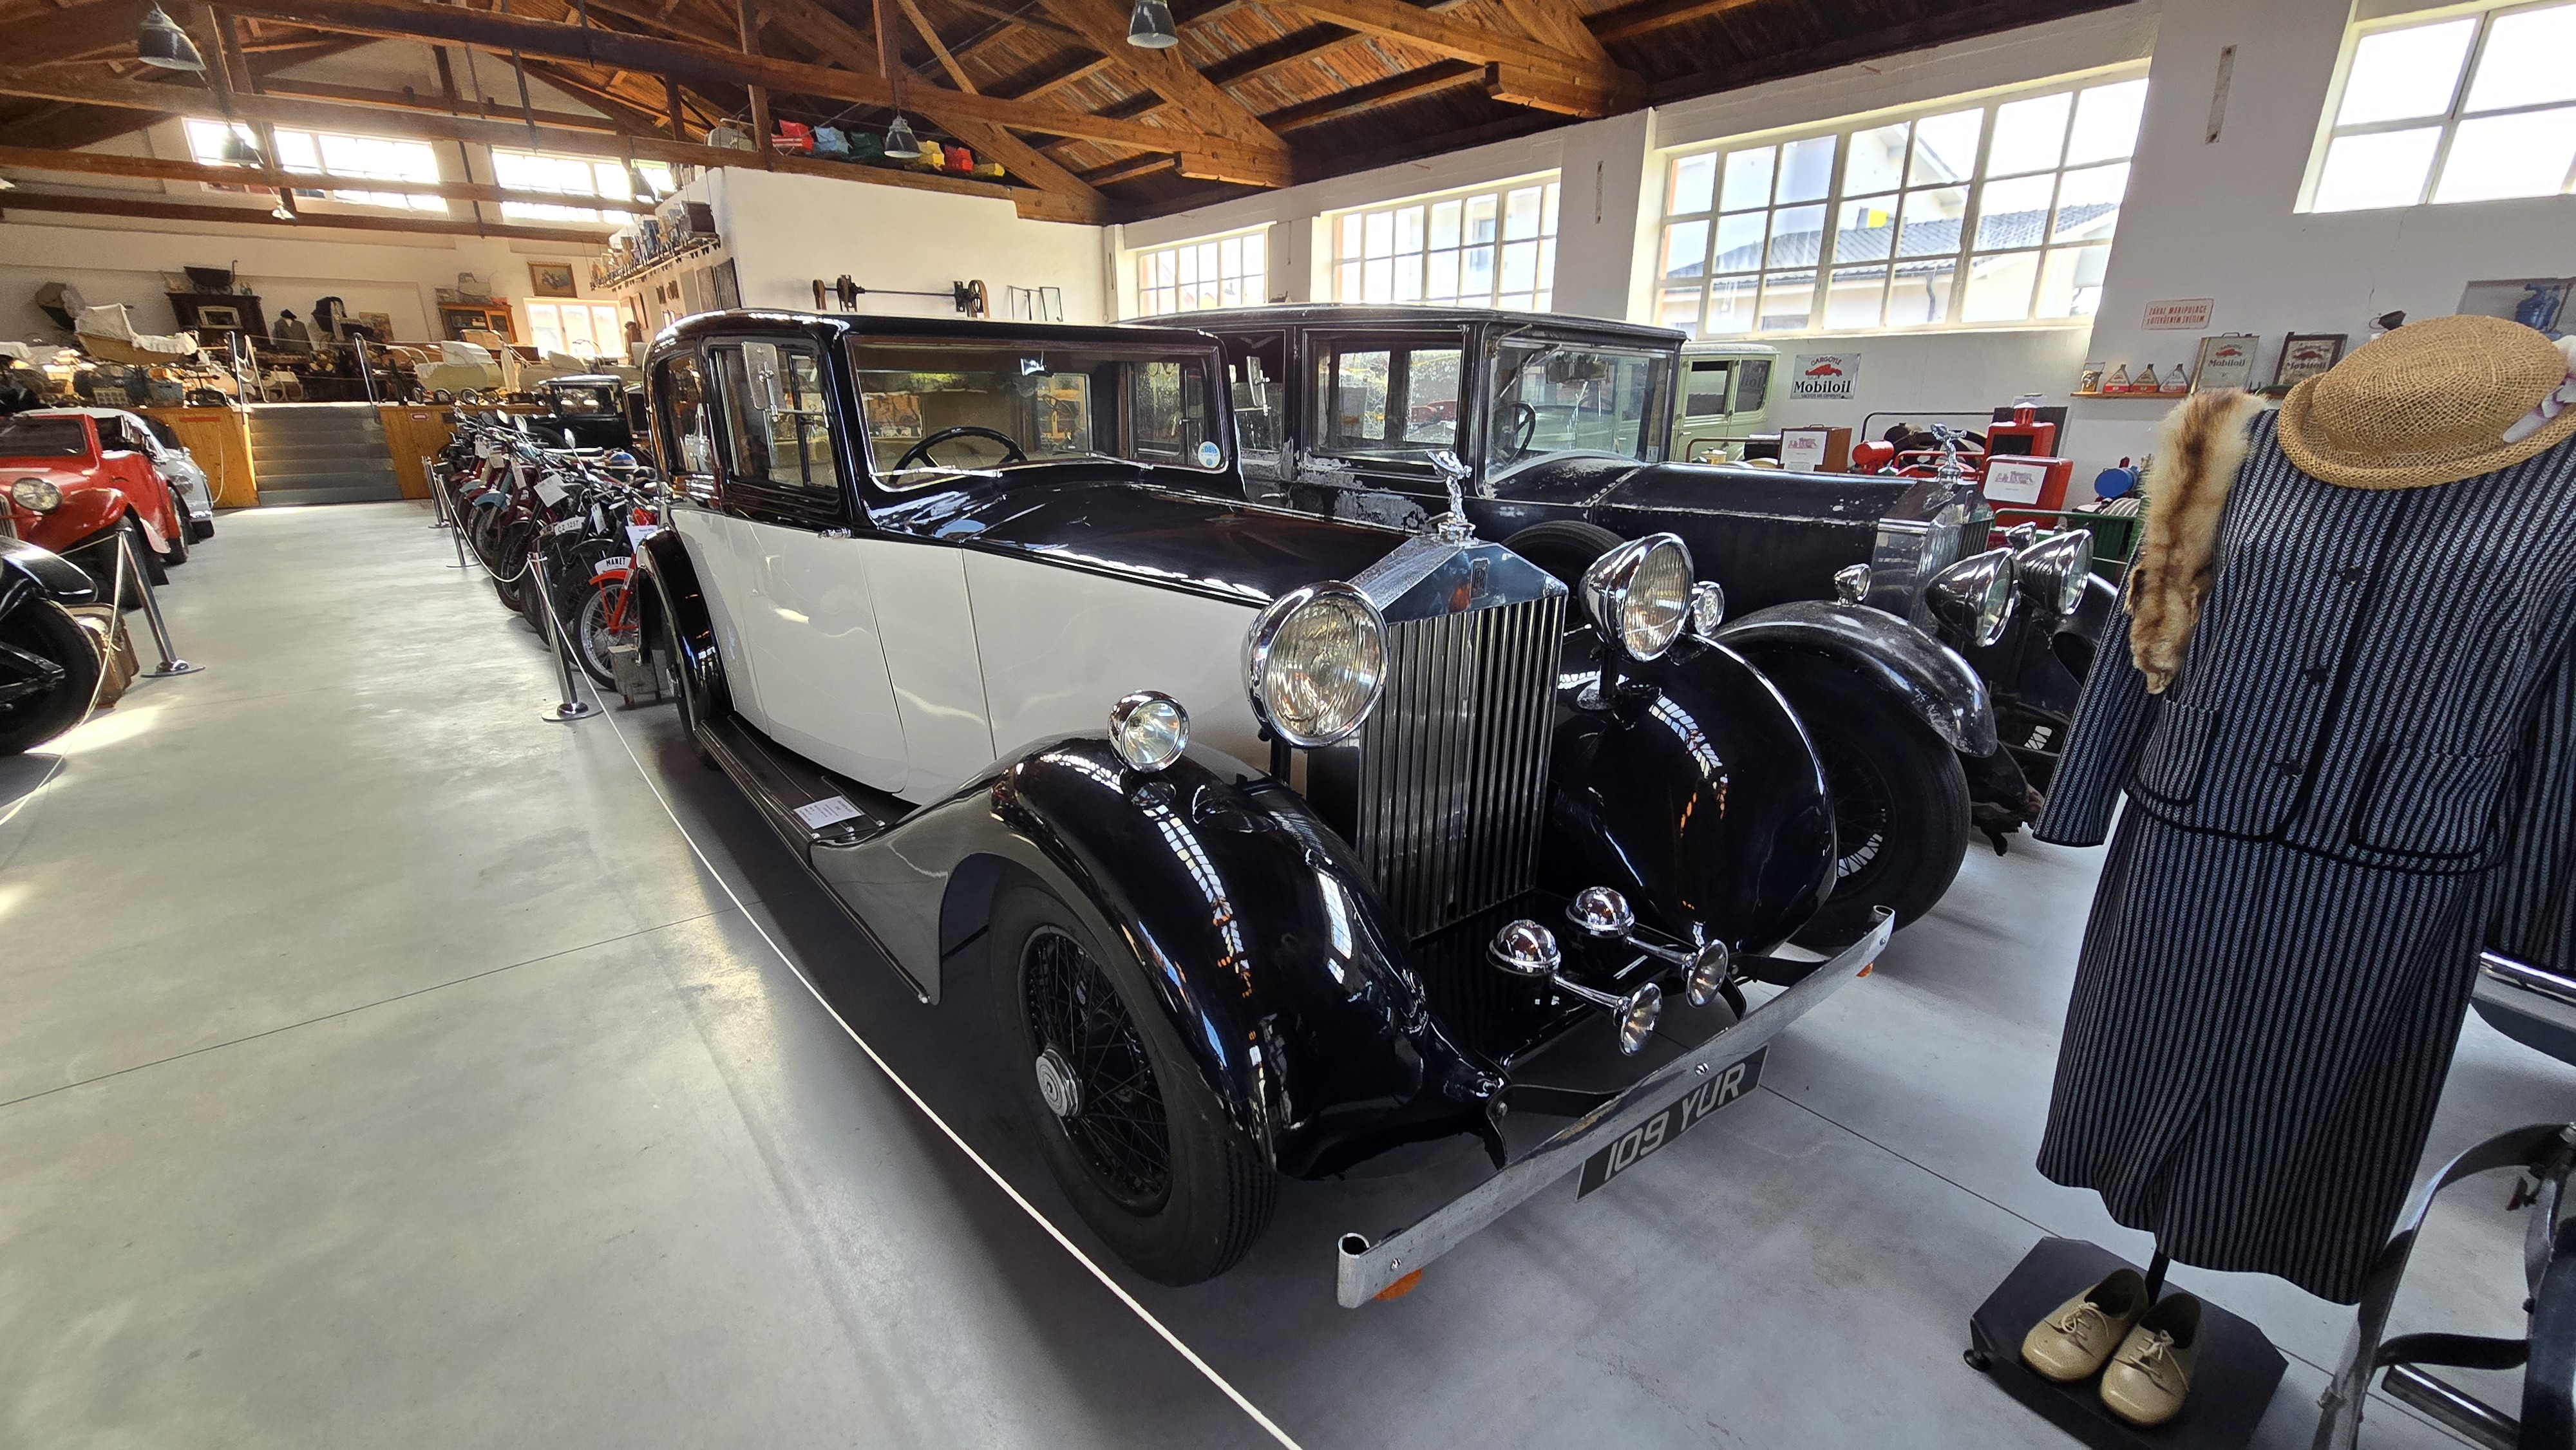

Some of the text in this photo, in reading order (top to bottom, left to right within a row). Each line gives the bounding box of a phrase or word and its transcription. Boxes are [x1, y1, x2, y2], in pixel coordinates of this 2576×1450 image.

[1810, 356, 1842, 366] GARGOYLE
[1794, 381, 1852, 393] Mobiloil
[605, 557, 626, 567] MANET
[1604, 1062, 1747, 1182] 109 YUR
